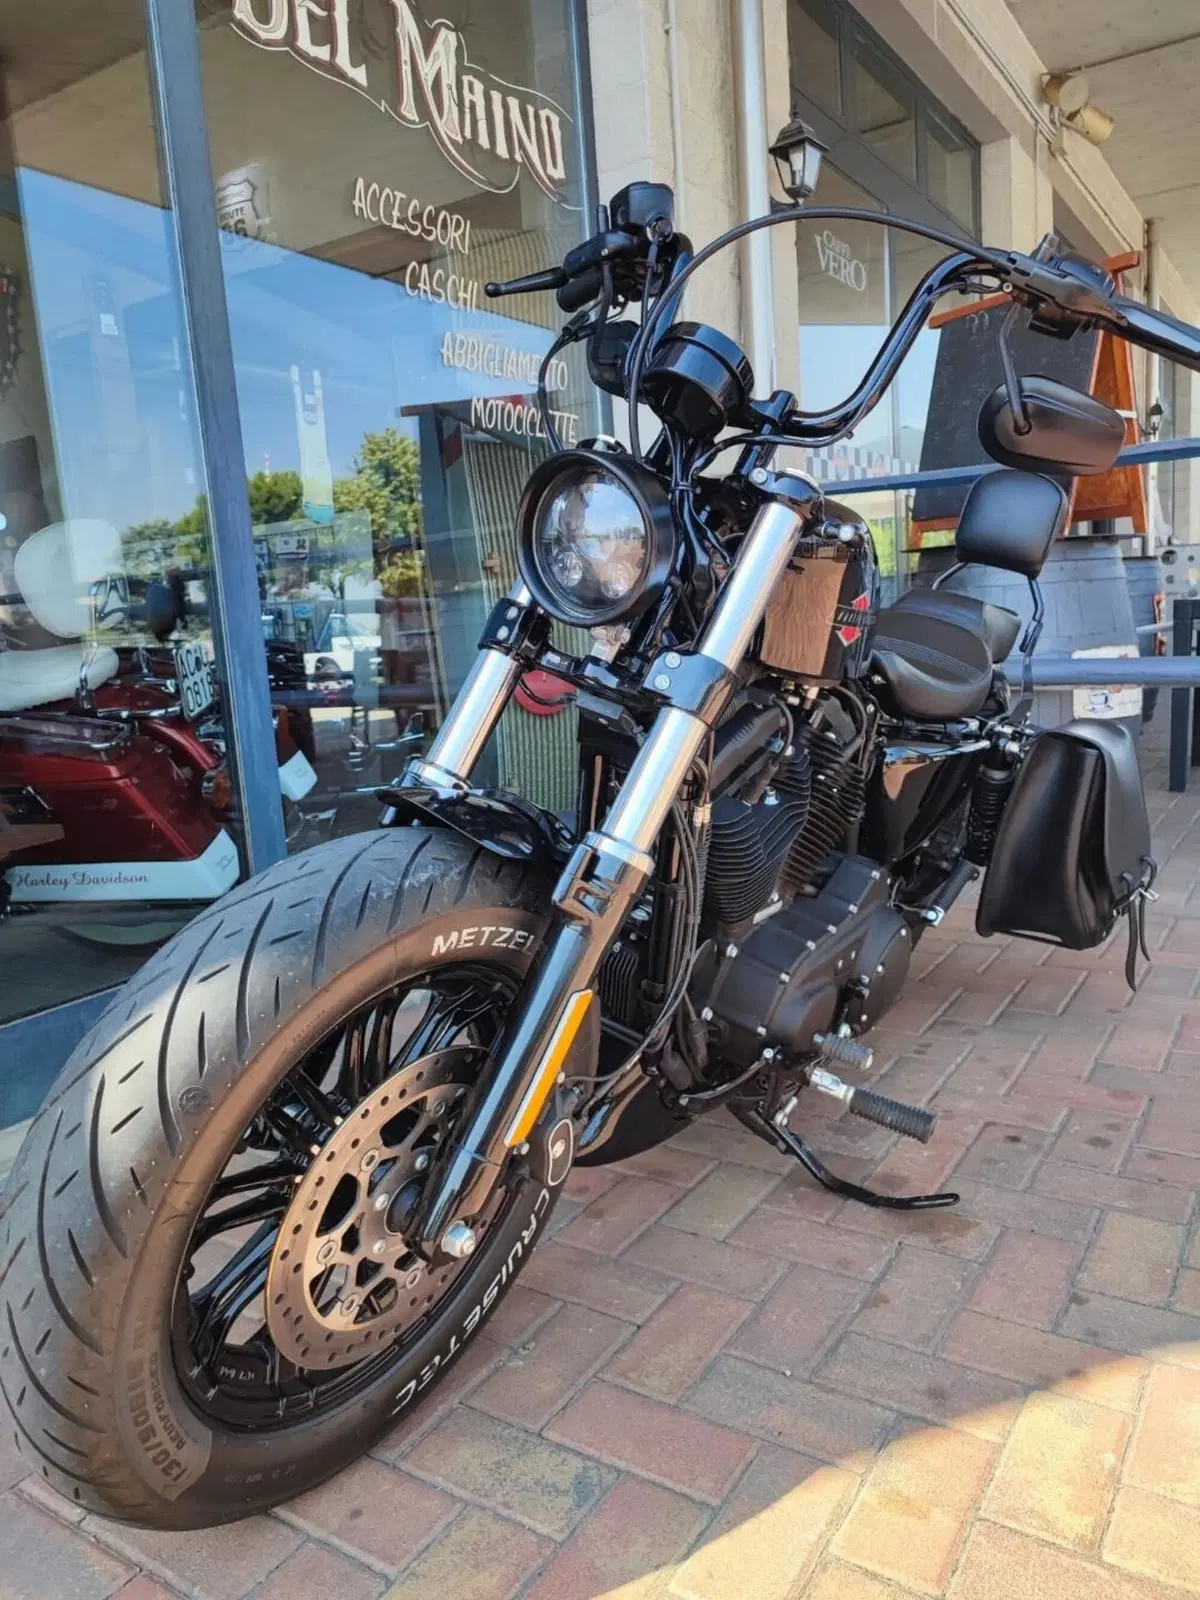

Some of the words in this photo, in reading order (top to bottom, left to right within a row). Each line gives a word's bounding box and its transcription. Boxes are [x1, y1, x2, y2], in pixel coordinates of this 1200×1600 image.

[352, 177, 471, 254] ACCESSORI
[405, 261, 478, 312] CASCHI
[813, 233, 867, 292] VERO
[439, 331, 568, 391] ABBIGLIAMETO
[471, 396, 579, 444] MOTOCICLTTE
